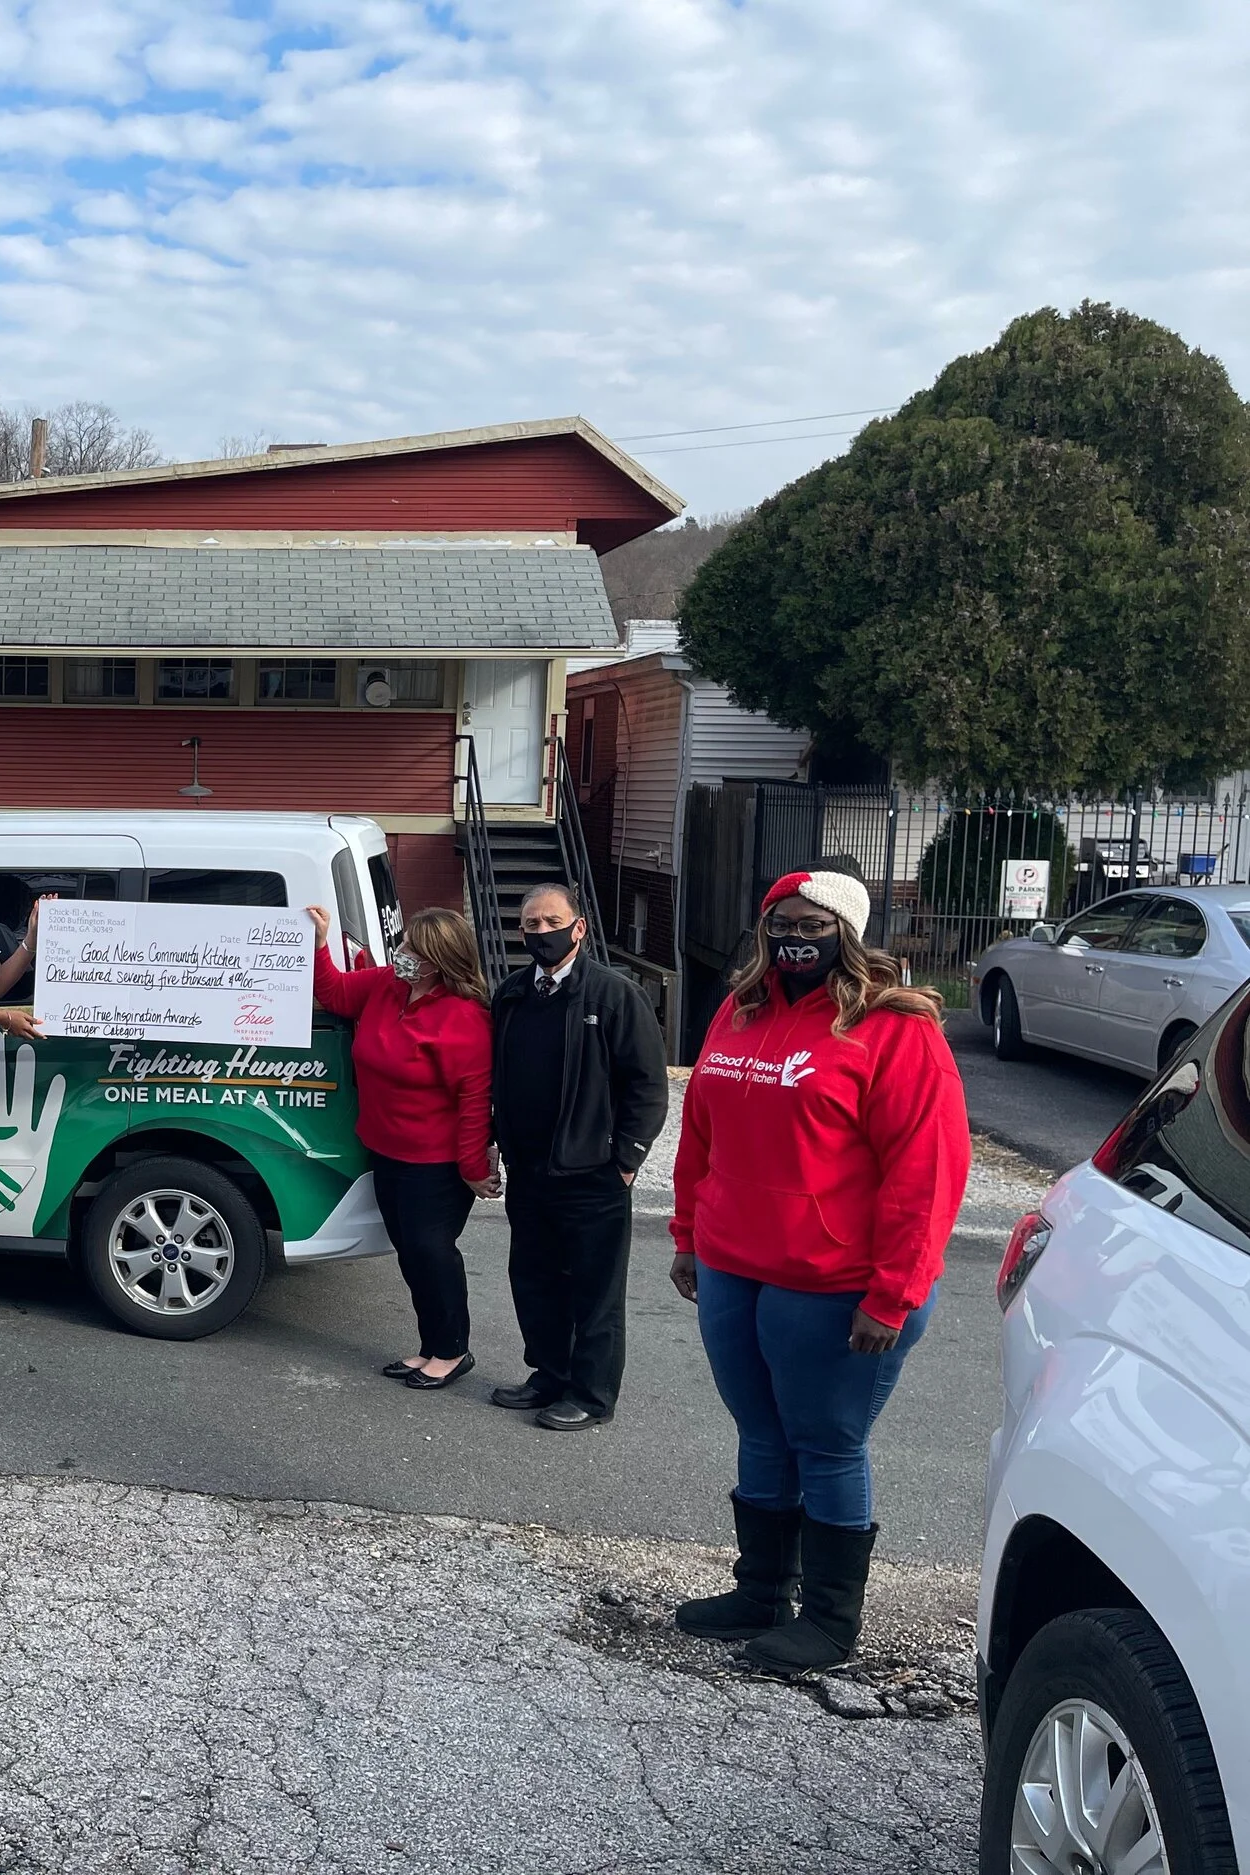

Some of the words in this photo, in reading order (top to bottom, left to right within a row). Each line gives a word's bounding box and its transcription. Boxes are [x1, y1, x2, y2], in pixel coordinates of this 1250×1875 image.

[48, 916, 66, 924] 5200
[67, 917, 106, 926] Buffington
[48, 924, 78, 933] Atlanta,
[220, 935, 241, 943] Date
[246, 922, 304, 947] 12/3/2020
[45, 939, 59, 948] Pay
[46, 947, 55, 955] To
[57, 947, 71, 955] The
[44, 955, 66, 963] Order
[80, 941, 111, 963] Good
[112, 940, 145, 963] News
[148, 941, 199, 974] Community
[200, 941, 242, 969] Kitchen
[46, 963, 69, 982] One
[70, 963, 112, 983] hundred
[116, 970, 155, 991] seventy
[158, 969, 180, 991] five
[181, 970, 225, 987] thousand
[267, 982, 299, 992] Dollars
[44, 1012, 59, 1021] For
[63, 1003, 91, 1020] 2020
[91, 1005, 114, 1021] True
[113, 1006, 162, 1024] Inspiration
[162, 1008, 203, 1026] Awards
[234, 1004, 274, 1026] True
[64, 1024, 100, 1037] Hunger
[102, 1025, 146, 1041] Category
[107, 1043, 222, 1083] Fighting
[224, 1045, 328, 1086] Hunger
[711, 1052, 746, 1068] Good
[745, 1057, 784, 1074] News
[700, 1064, 745, 1082] Community
[104, 1086, 149, 1103] ONE
[155, 1087, 214, 1104] MEAL
[219, 1088, 247, 1105] AT
[253, 1090, 269, 1106] A
[275, 1090, 326, 1108] TIME
